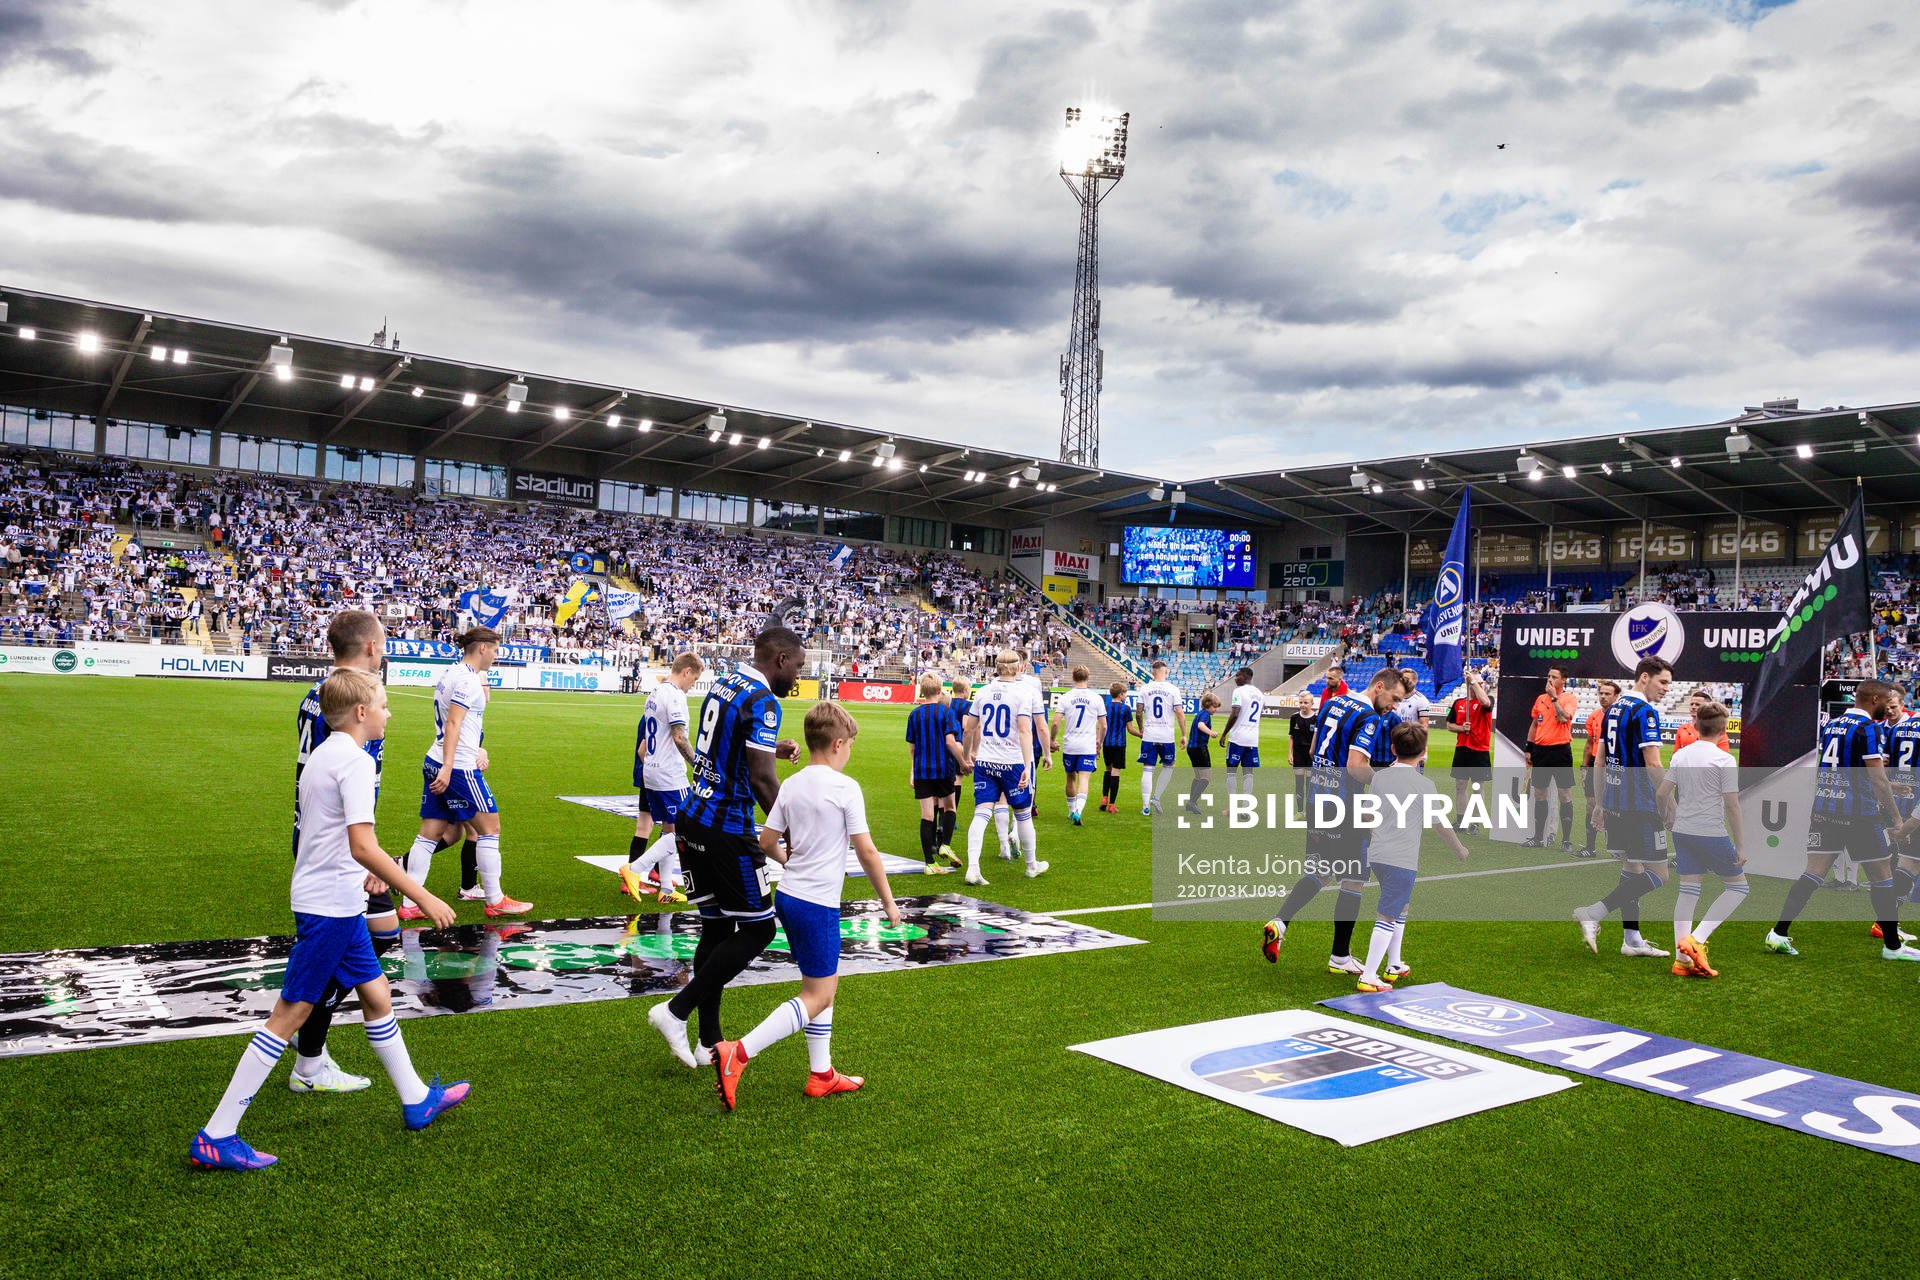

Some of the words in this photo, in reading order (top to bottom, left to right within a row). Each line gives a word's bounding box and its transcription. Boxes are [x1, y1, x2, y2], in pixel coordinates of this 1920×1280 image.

[515, 473, 594, 498] stadium
[1012, 535, 1041, 549] MAXI
[1229, 534, 1251, 542] 00:00
[1617, 535, 1686, 558] 1945
[1709, 531, 1779, 555] 1946
[1804, 526, 1881, 551] 197
[1055, 551, 1089, 570] MAXI
[1543, 539, 1600, 560] 1943
[1284, 563, 1308, 576] pre
[1284, 576, 1316, 587] zero
[1515, 628, 1595, 646] UNIBET
[1632, 624, 1648, 633] IFK
[1634, 625, 1666, 649] NORRKÖPING
[385, 640, 436, 656] URVA
[499, 646, 546, 662] DAHL
[1064, 612, 1156, 685] NORDAH
[161, 657, 244, 673] HOLMEN
[271, 664, 328, 677] stadium
[399, 669, 432, 678] SEFAB
[540, 671, 599, 689] Flinks
[1075, 705, 1085, 728] 7
[1152, 696, 1163, 718] 6
[1248, 701, 1259, 722] 2
[697, 698, 720, 754] 9
[982, 703, 1011, 738] 20
[647, 716, 657, 755] 8
[1318, 717, 1338, 755] 7
[1607, 719, 1618, 754] 5
[1822, 737, 1839, 771] 4
[1898, 740, 1914, 771] 2
[488, 799, 494, 807] 9
[1762, 800, 1788, 832] U
[1404, 1004, 1507, 1031] ALLSVENSKAN
[1283, 1039, 1318, 1053] 19
[1308, 1027, 1470, 1077] SIRIUS
[1376, 1068, 1416, 1082] 07
[1504, 1031, 1920, 1147] ALLS
